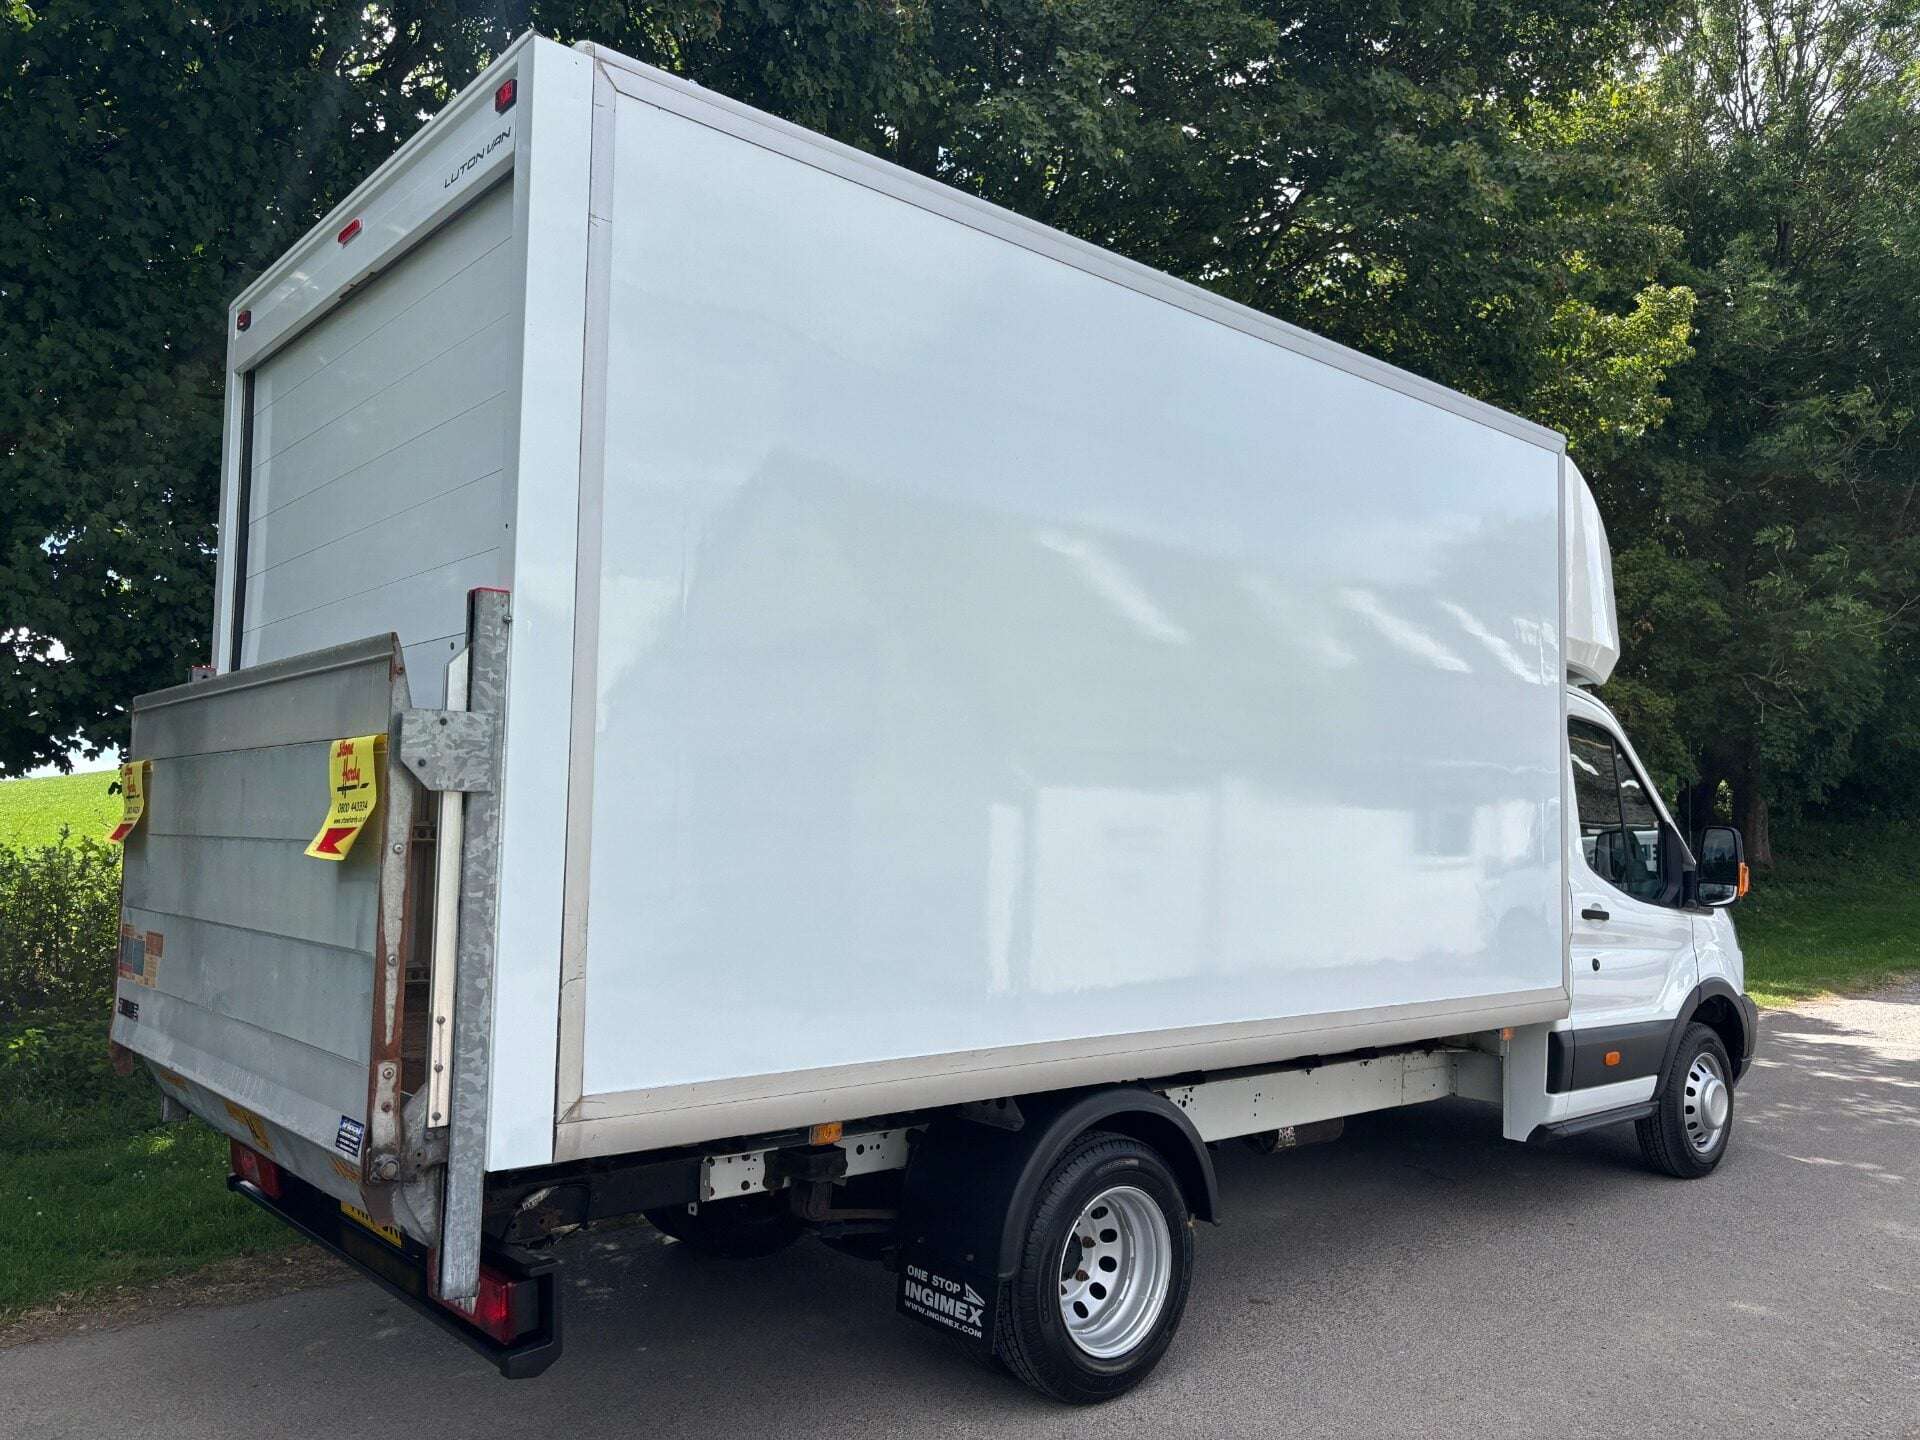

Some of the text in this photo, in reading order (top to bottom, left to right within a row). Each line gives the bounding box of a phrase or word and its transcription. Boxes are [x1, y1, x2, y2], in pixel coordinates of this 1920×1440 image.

[444, 126, 511, 189] LUTON VAN
[337, 802, 350, 814] 0800
[907, 1264, 961, 1294] ONE STOP
[904, 1299, 982, 1339] WWW.INGIMEX.COM
[905, 1279, 984, 1328] INGIMEX
